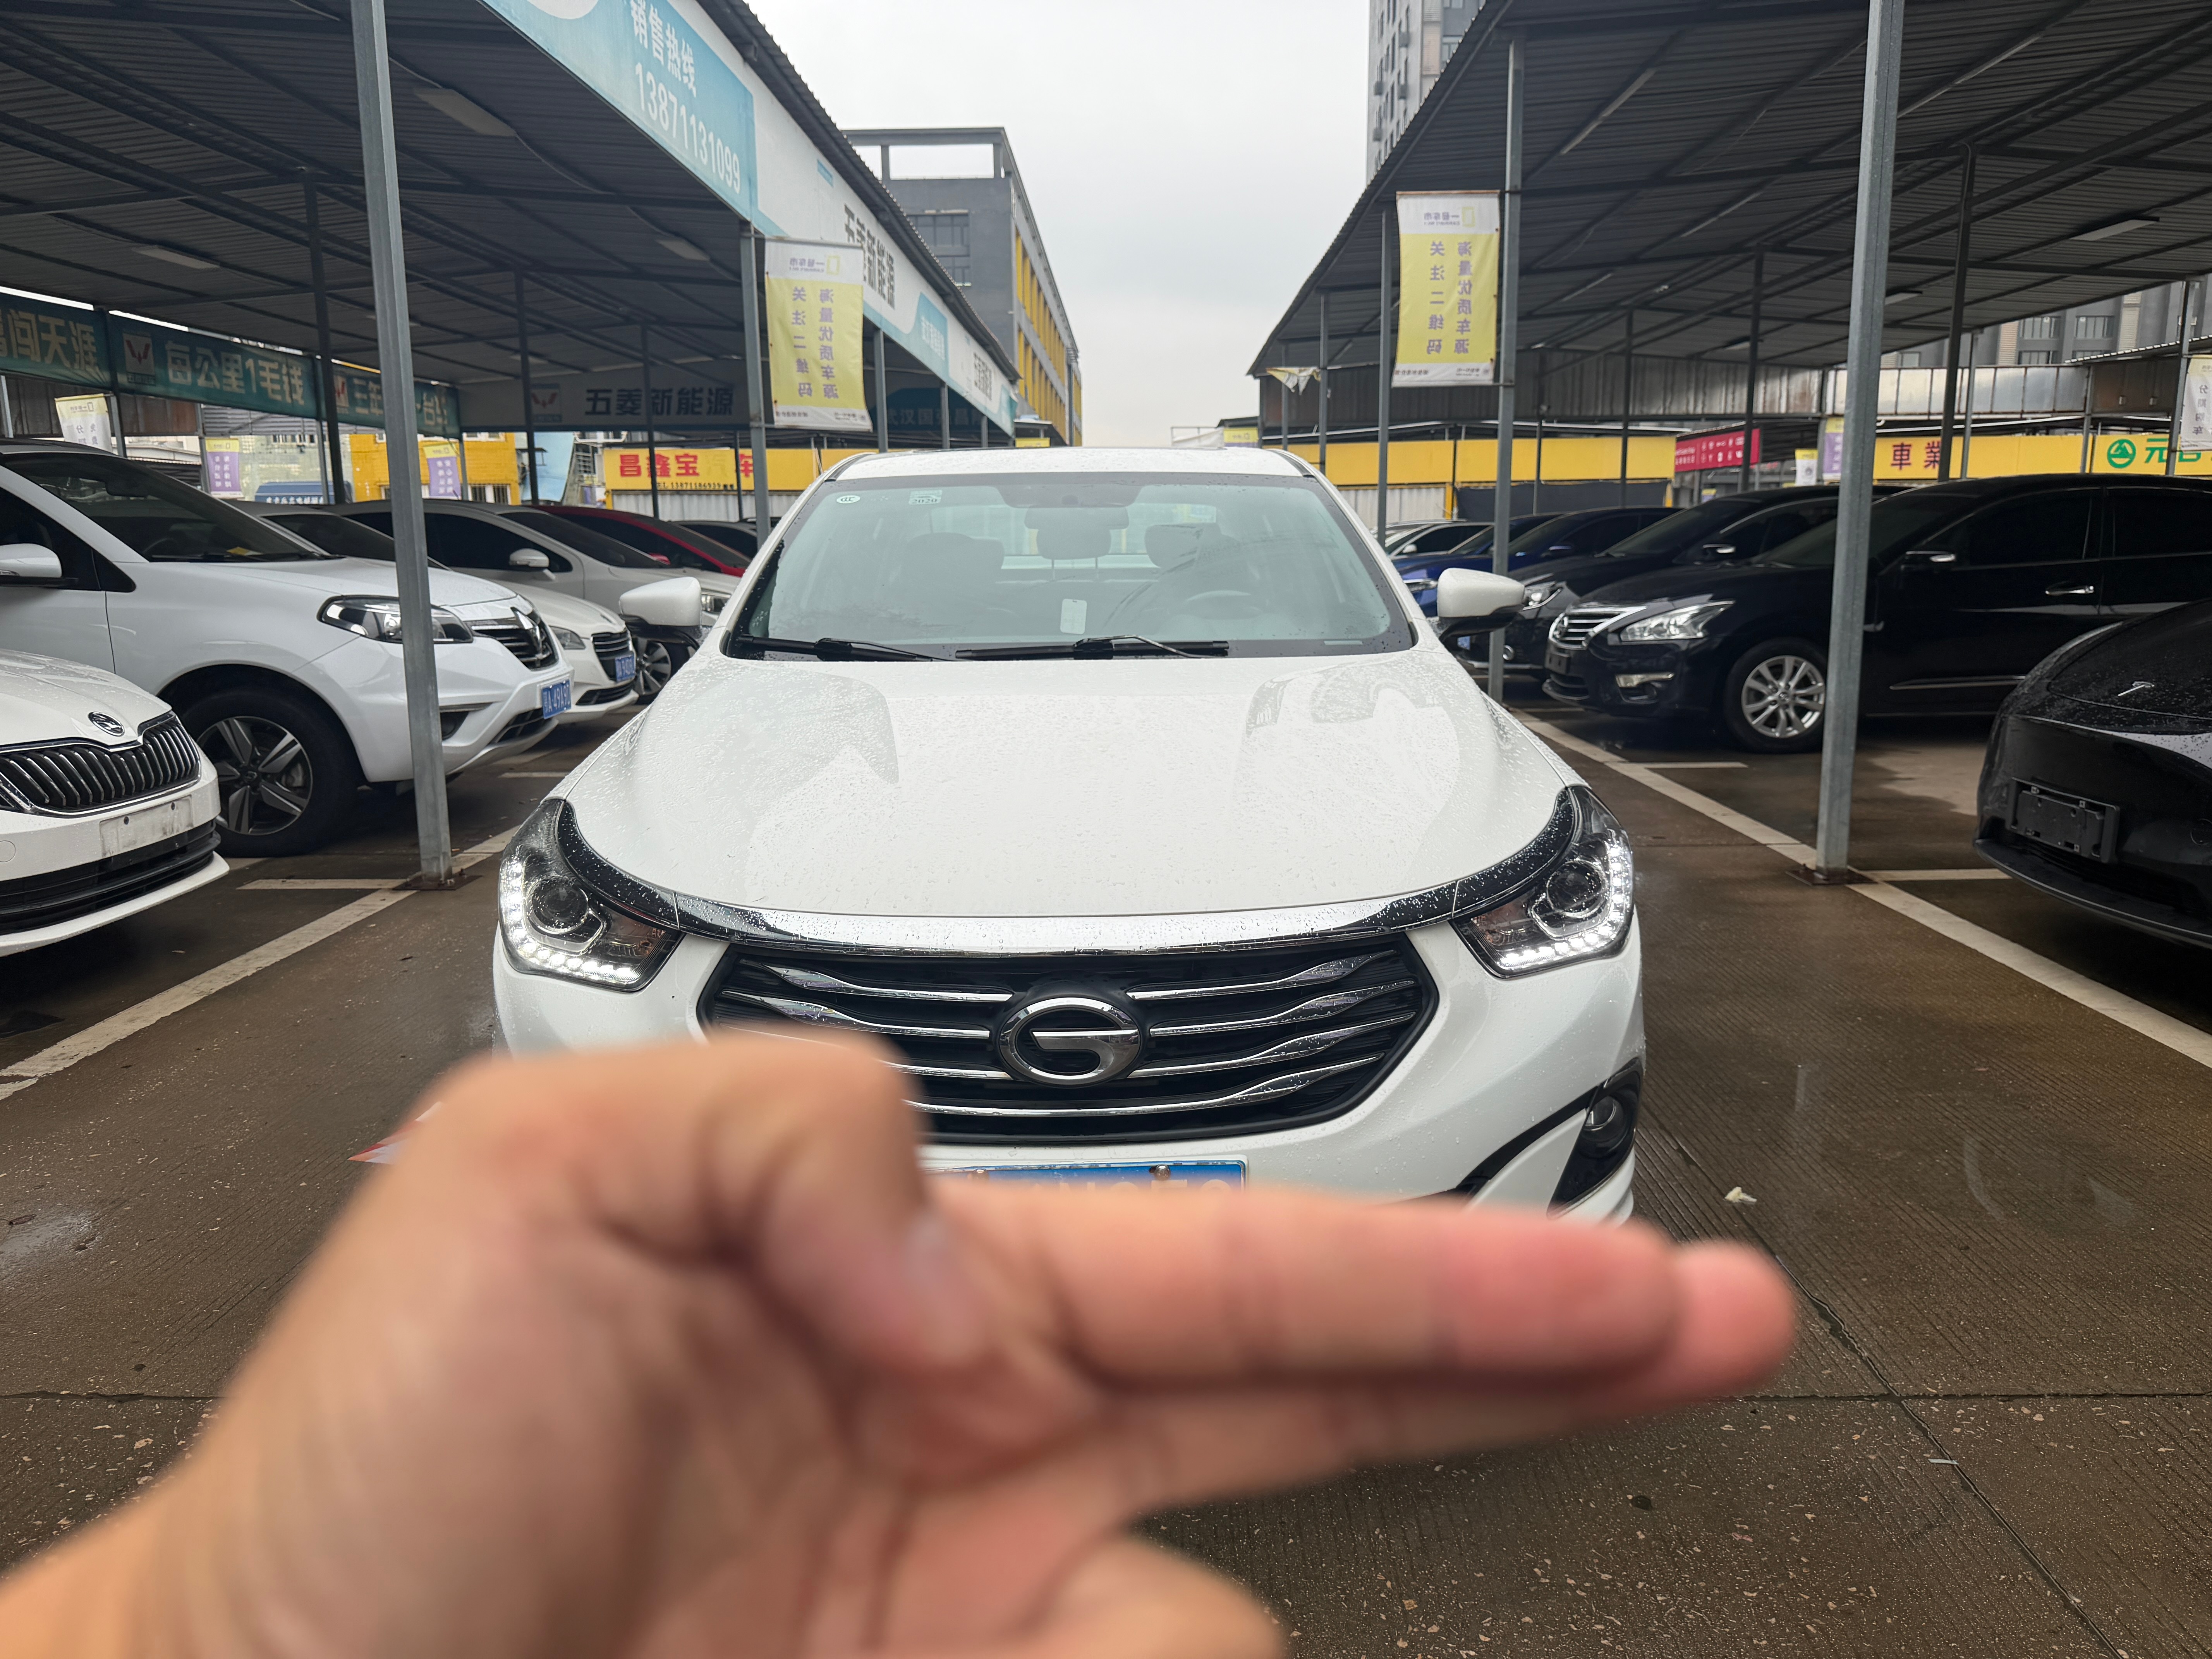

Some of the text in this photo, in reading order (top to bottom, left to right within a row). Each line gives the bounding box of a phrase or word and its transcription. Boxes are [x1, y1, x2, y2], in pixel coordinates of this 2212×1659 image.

[630, 0, 696, 97] 销售热线
[635, 62, 741, 194] 13871131099
[165, 340, 305, 405] 每公里1毛钱
[585, 387, 734, 416] 五菱新能源
